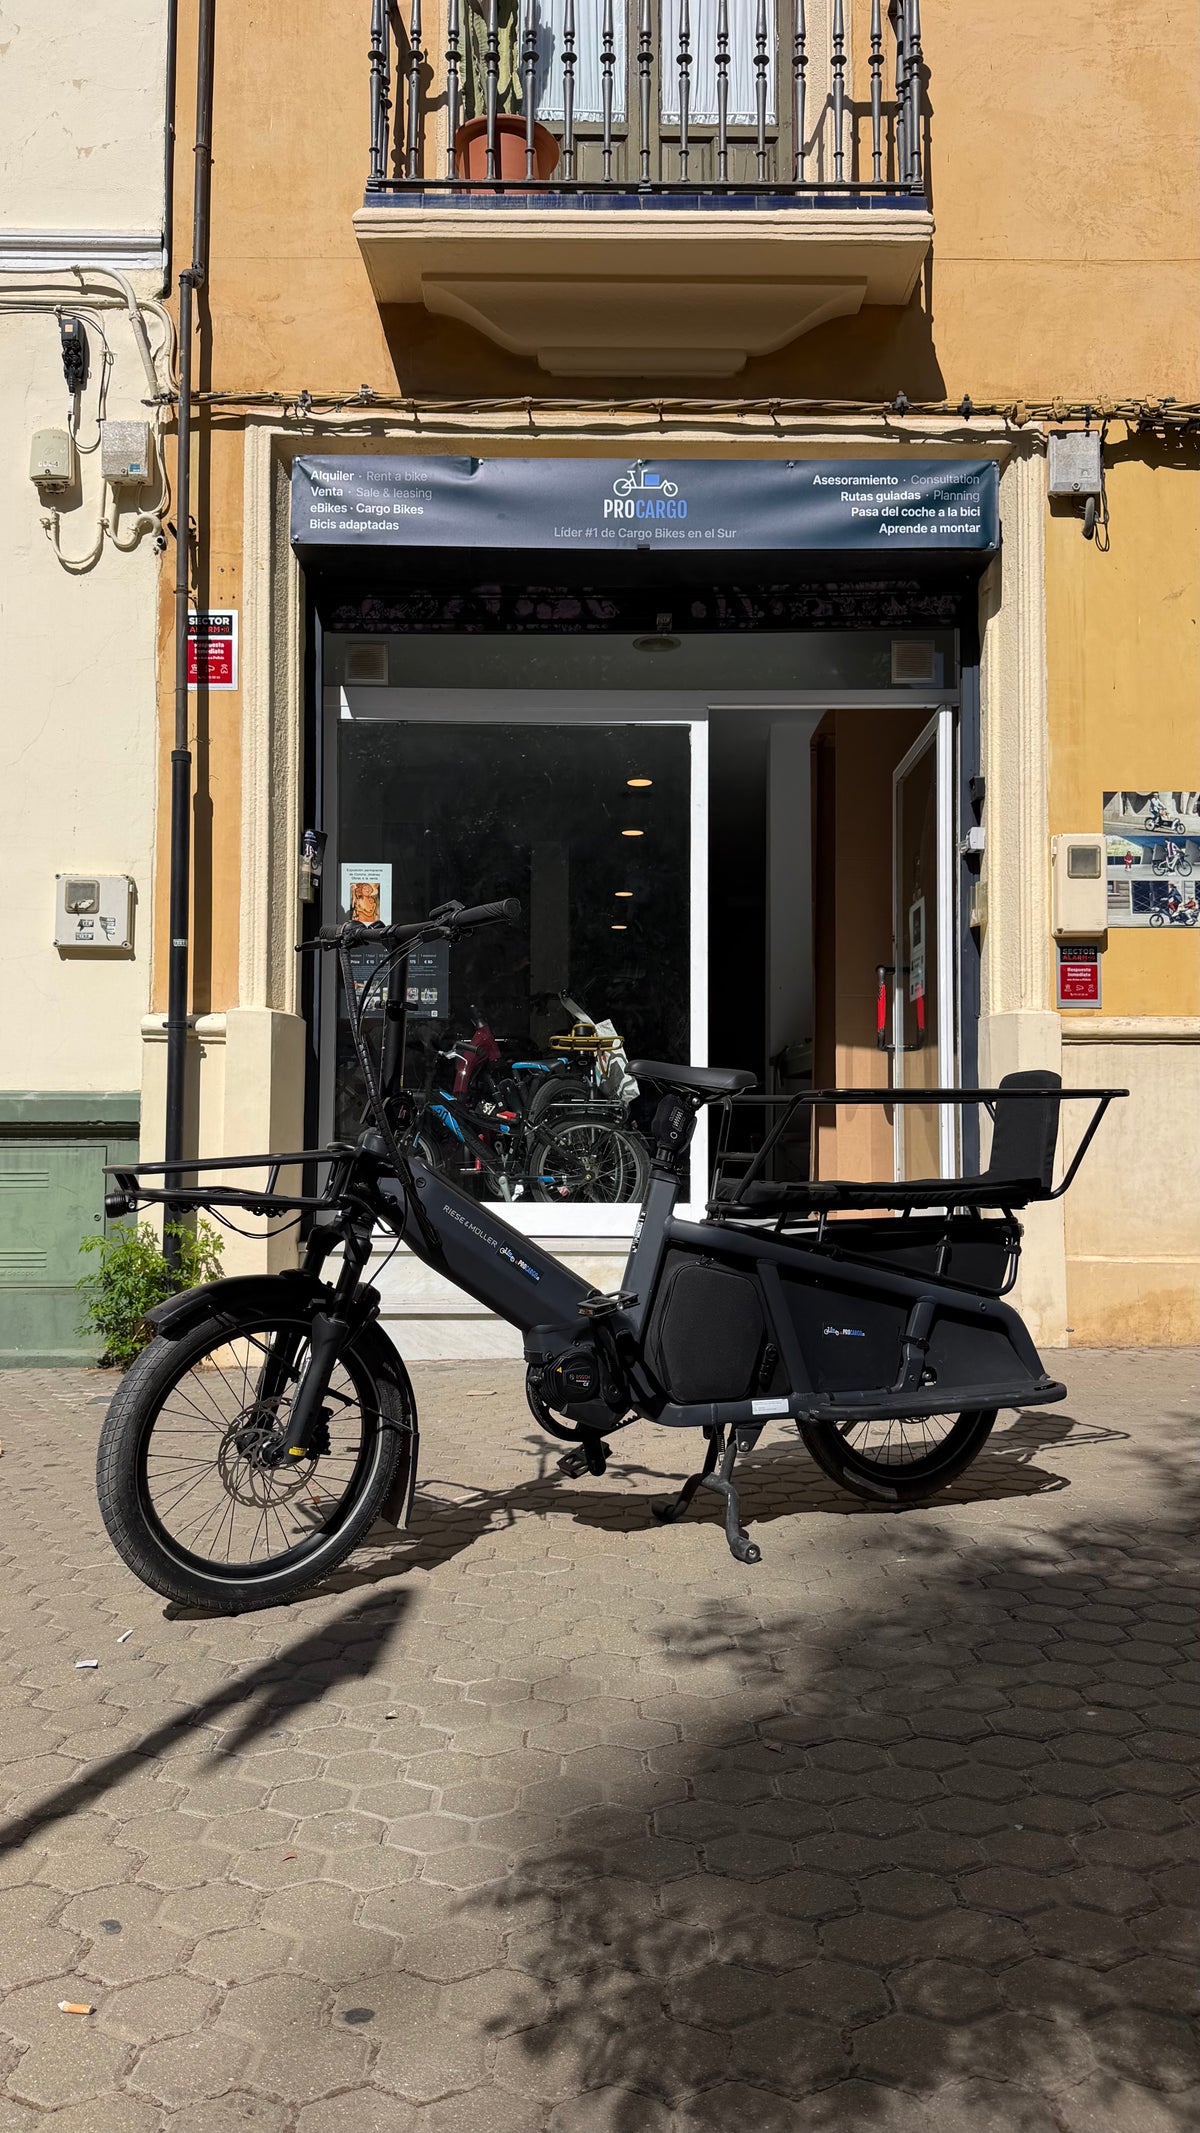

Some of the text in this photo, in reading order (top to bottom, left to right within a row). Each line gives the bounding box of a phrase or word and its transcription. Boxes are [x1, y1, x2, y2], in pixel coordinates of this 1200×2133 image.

[310, 470, 428, 482] Alquiler Rent a bike
[812, 474, 980, 485] Asesoramiento Consultation
[310, 486, 432, 500] Venta Sale & leasing
[841, 490, 980, 503] Rutas guiadas Planning
[310, 503, 424, 515] eBikes Cargo Bikes
[603, 499, 688, 519] PROCARGO
[851, 506, 981, 517] Pasa del coche a la bici
[309, 519, 400, 531] Bicis adaptadas
[879, 523, 981, 536] Aprende a montar
[554, 527, 737, 541] Líder #1 de Cargo Bikes en el Sur
[188, 617, 230, 625] SECTOR
[442, 1204, 466, 1225] RIESE
